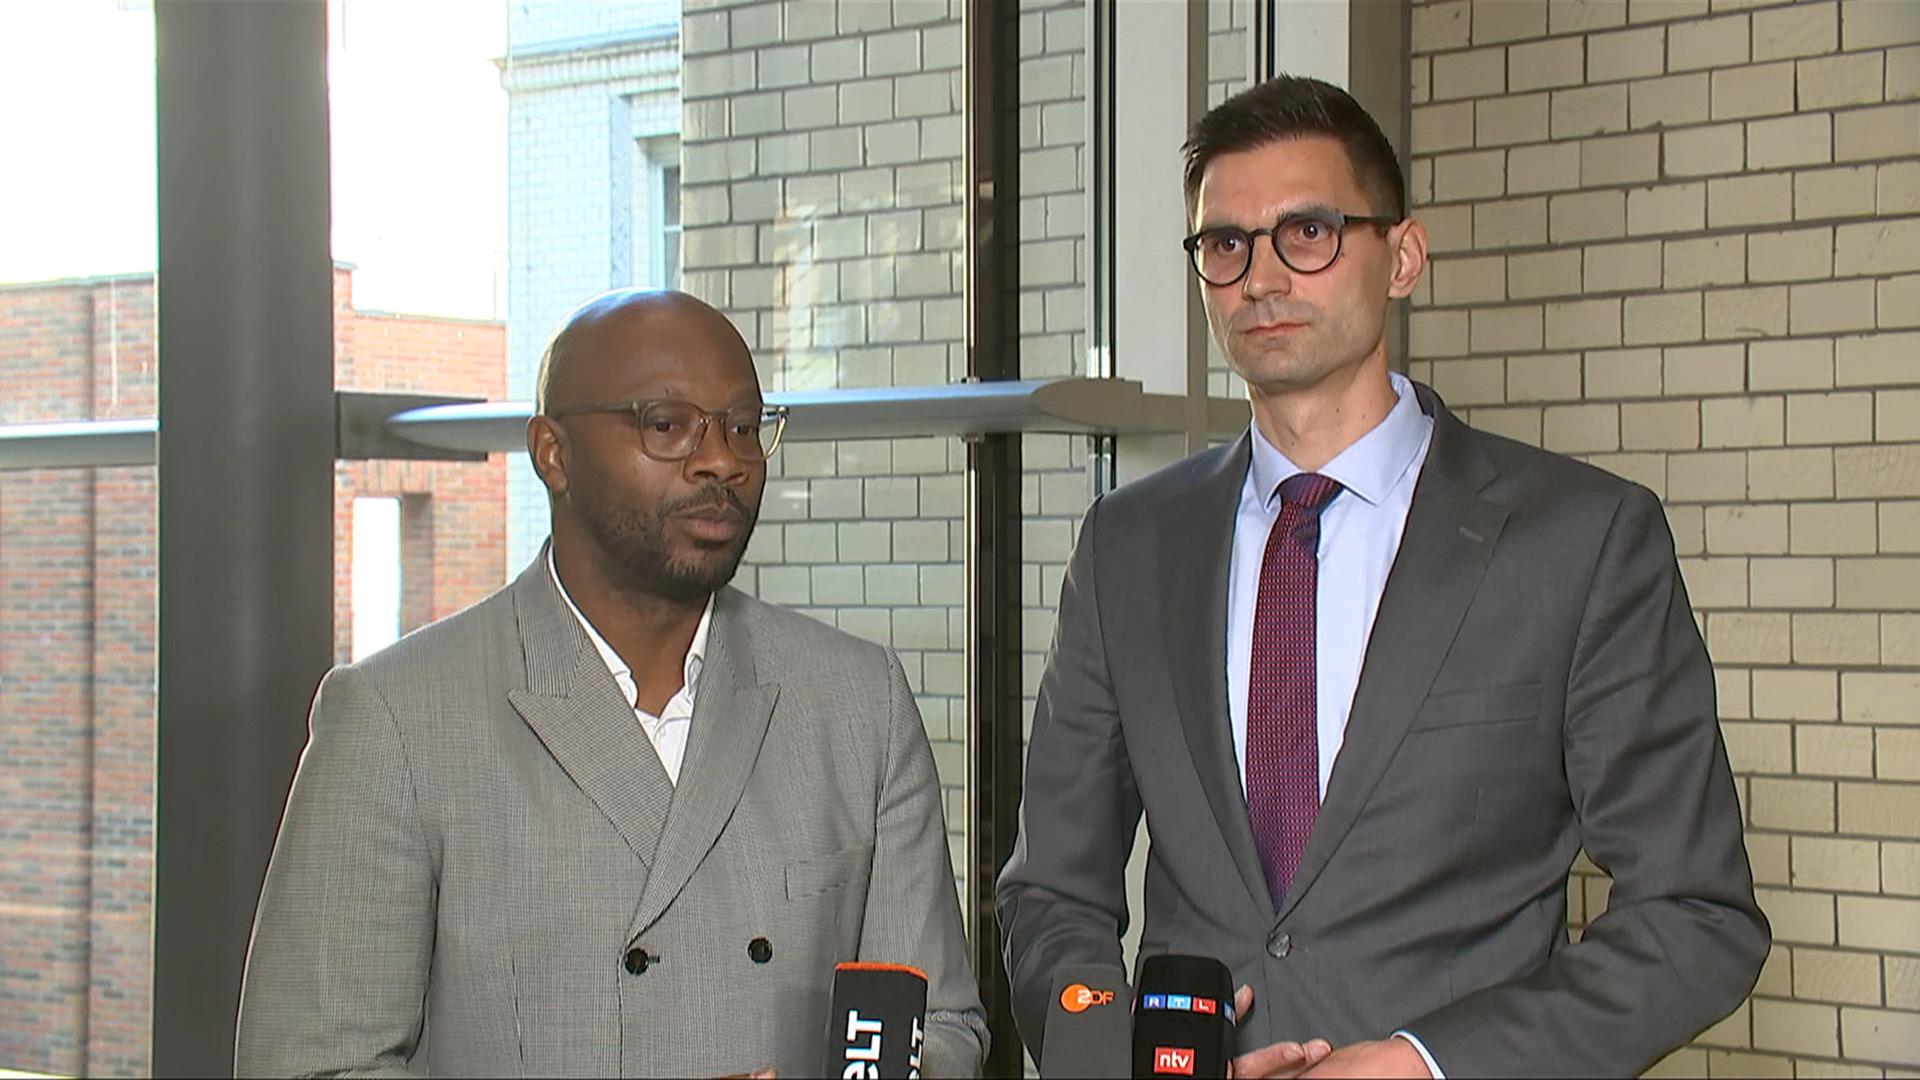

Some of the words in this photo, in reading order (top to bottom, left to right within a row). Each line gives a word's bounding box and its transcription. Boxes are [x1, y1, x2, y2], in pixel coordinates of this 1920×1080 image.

[1077, 989, 1114, 1005] ZDF
[1147, 996, 1211, 1012] RTL
[1160, 1050, 1190, 1068] ntv
